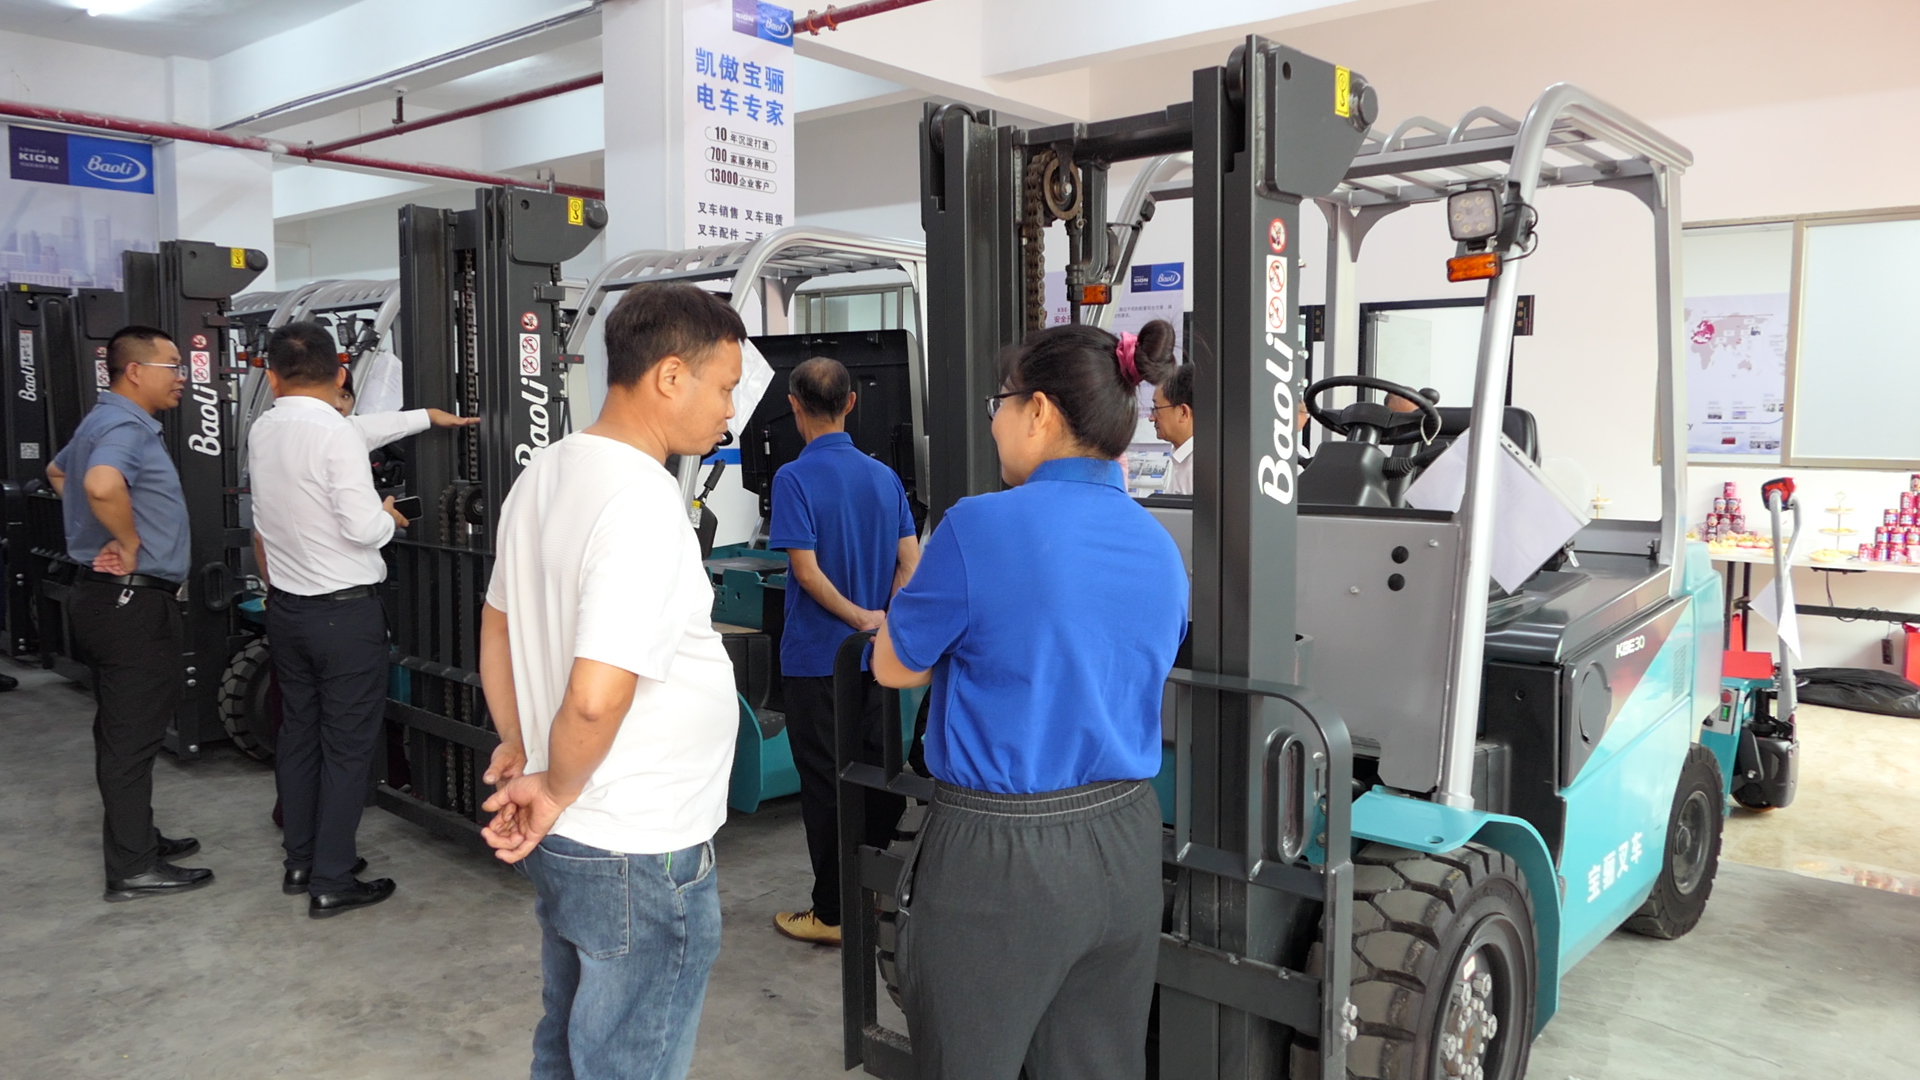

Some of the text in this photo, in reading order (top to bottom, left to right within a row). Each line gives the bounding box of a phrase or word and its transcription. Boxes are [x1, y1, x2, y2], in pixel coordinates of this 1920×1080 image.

[695, 47, 784, 95] 凯傲宝骊
[697, 82, 784, 126] 电车专家
[715, 126, 727, 141] 10
[18, 152, 59, 164] KION
[87, 155, 133, 175] Baoli
[711, 146, 769, 170] 700 家服务网络
[698, 202, 783, 226] 叉车销售 叉车租赁
[698, 224, 739, 241] 叉车配件
[18, 365, 37, 402] Baoli
[188, 384, 221, 457] Baoli
[1257, 332, 1294, 505] Baoli
